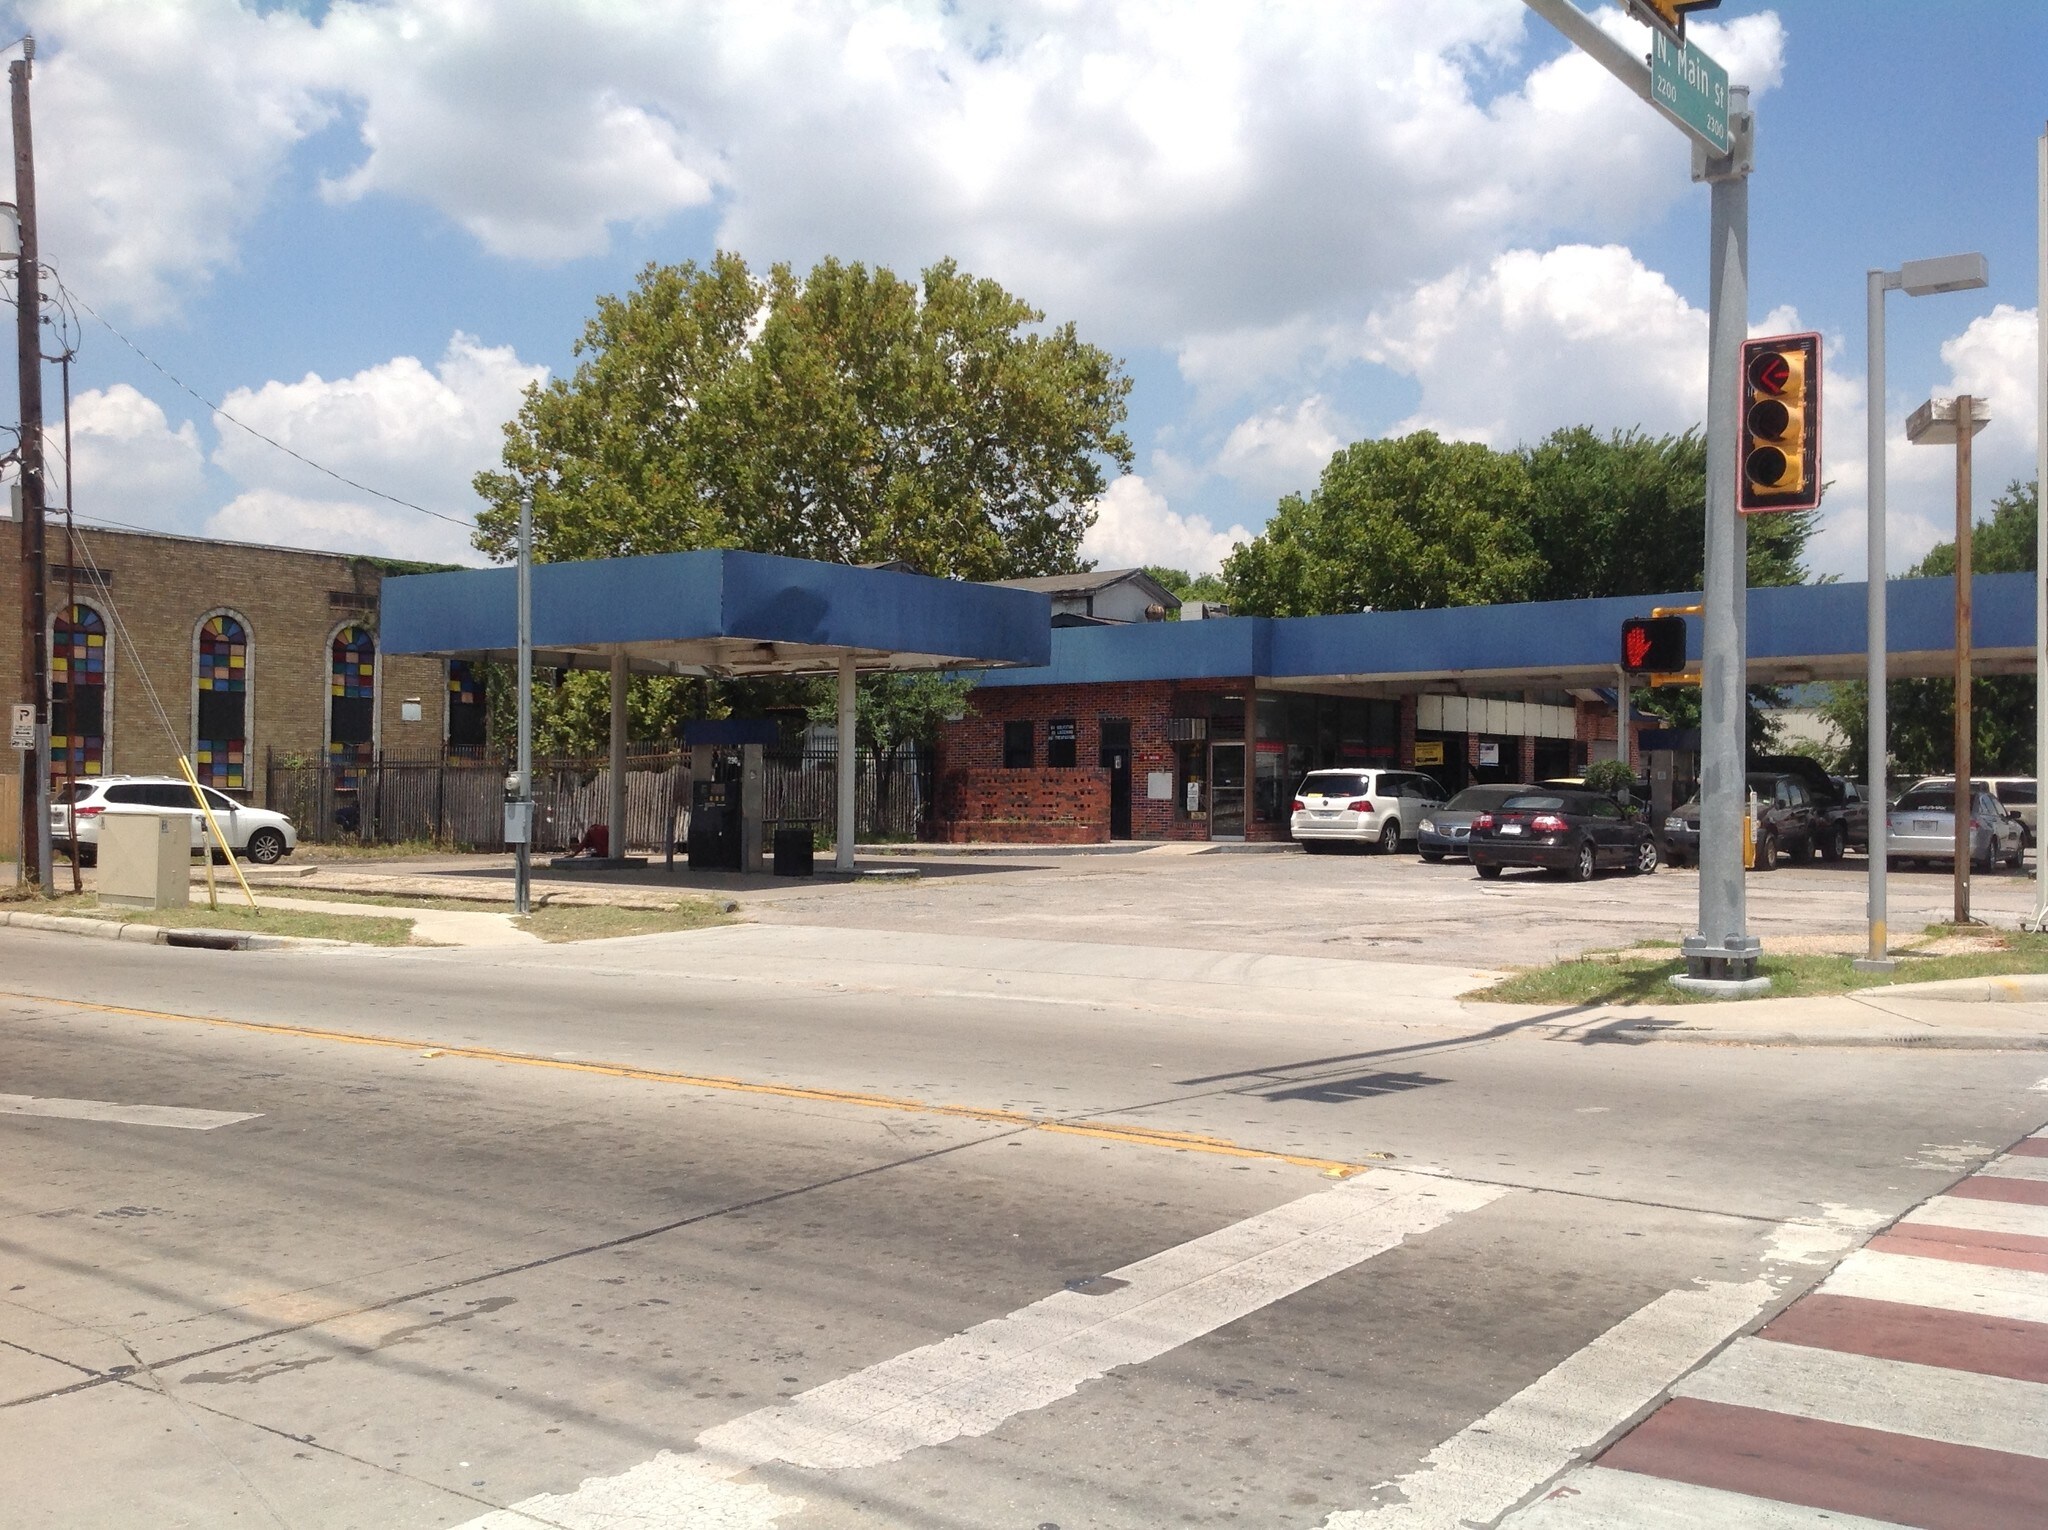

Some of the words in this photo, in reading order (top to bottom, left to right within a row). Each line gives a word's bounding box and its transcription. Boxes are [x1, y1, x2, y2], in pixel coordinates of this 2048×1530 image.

[1657, 31, 1671, 67] N.
[1677, 48, 1709, 97] Main
[1714, 83, 1725, 109] St
[1657, 75, 1677, 103] 2200
[1707, 114, 1724, 140] 2300
